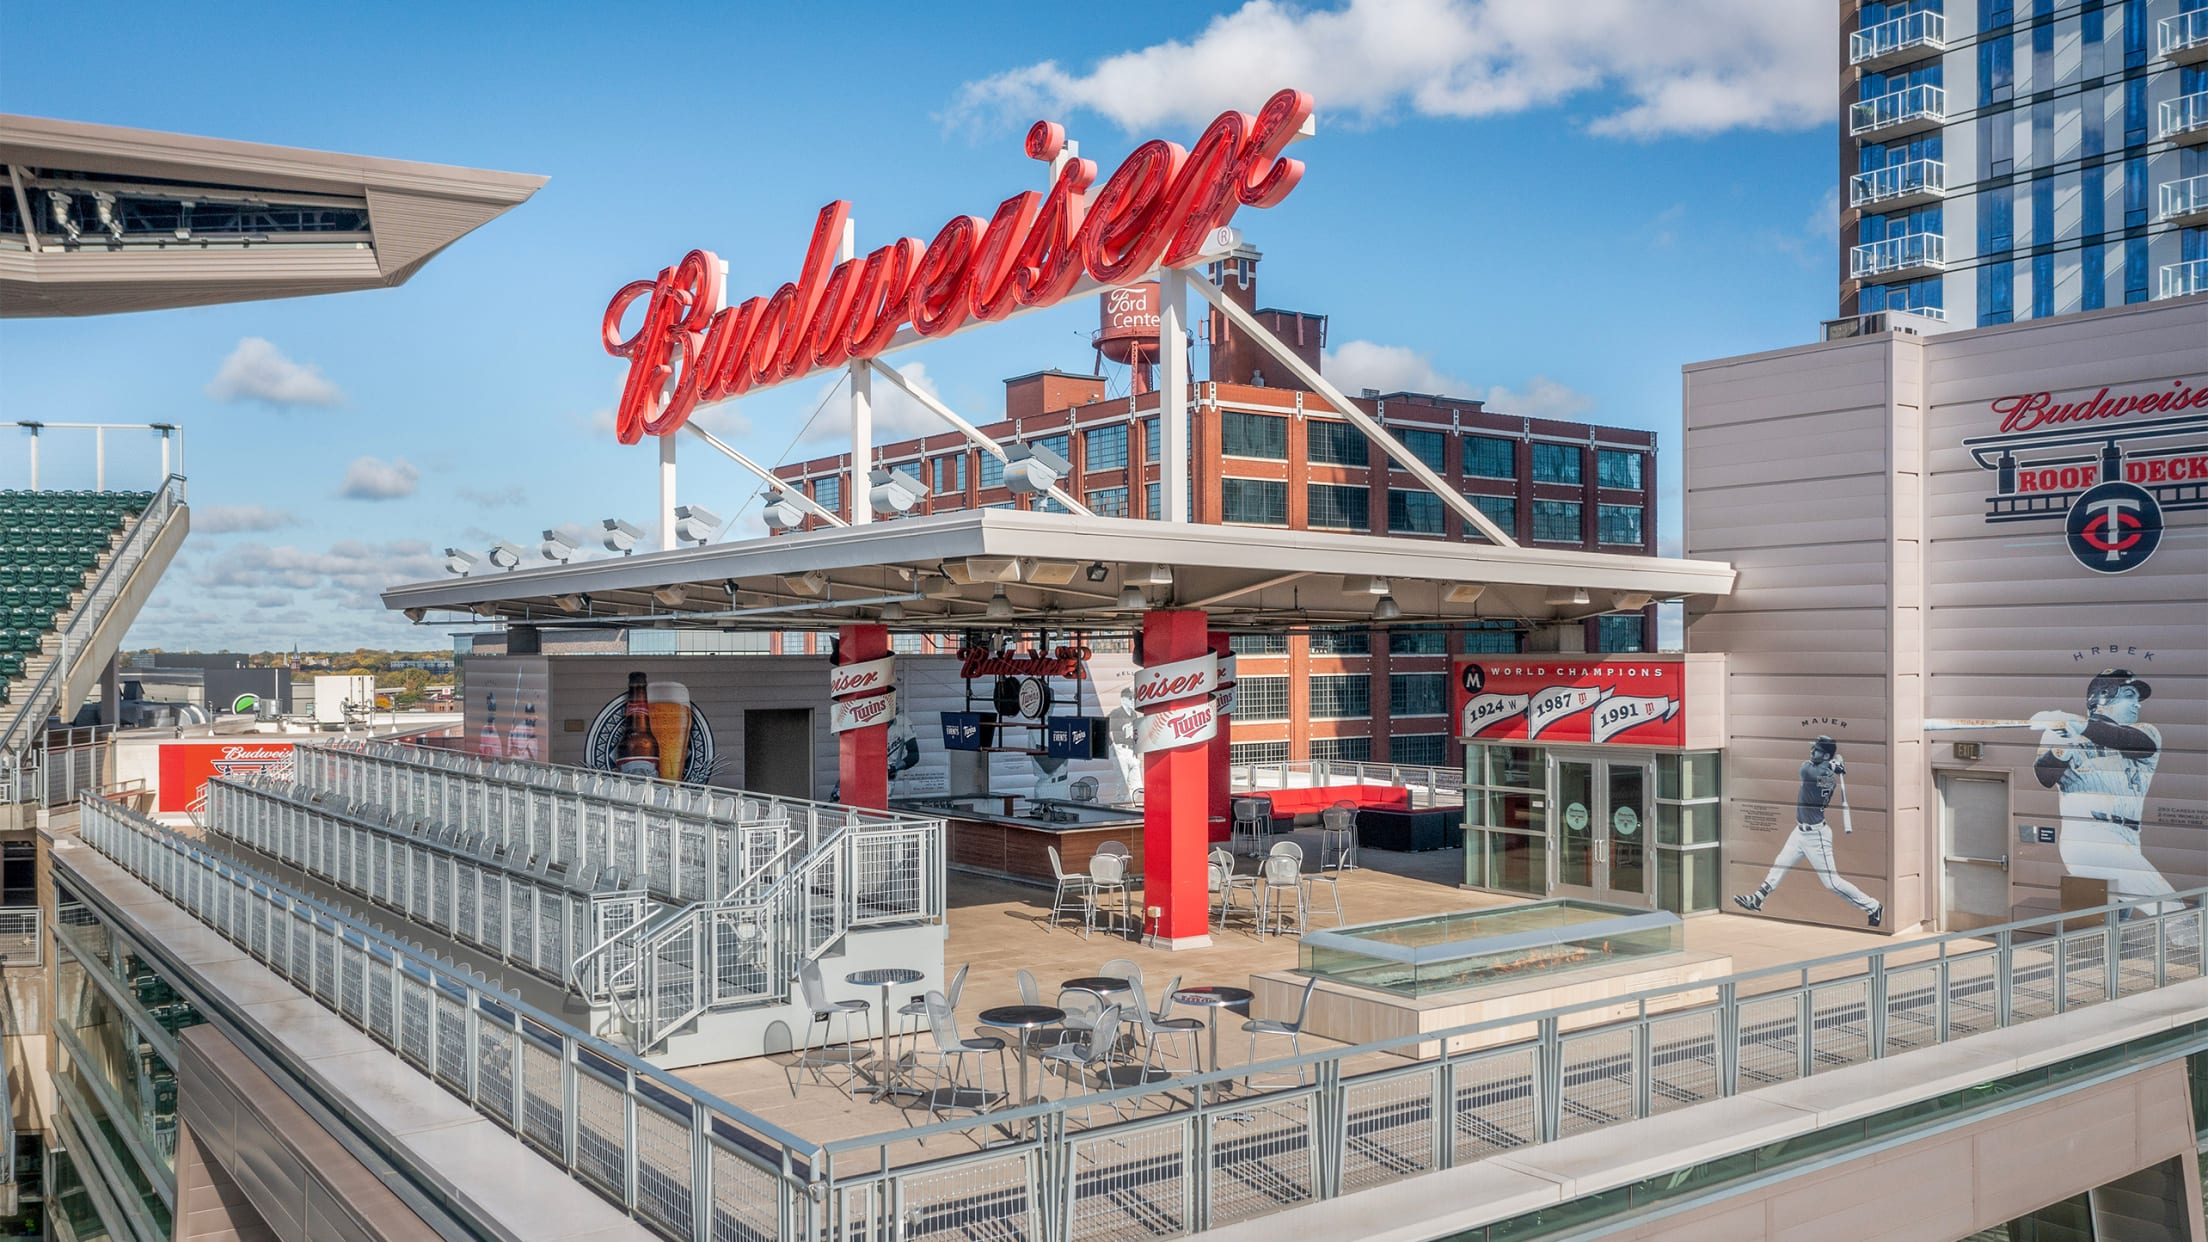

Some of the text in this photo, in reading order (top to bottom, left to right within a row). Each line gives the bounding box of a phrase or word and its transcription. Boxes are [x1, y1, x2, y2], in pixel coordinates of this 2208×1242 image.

[603, 88, 1314, 444] Budweiser
[1108, 288, 1147, 314] Ford
[1113, 313, 1160, 328] Cente
[2019, 457, 2208, 492] ROOF DECK
[2073, 644, 2155, 662] HRBEK
[1491, 667, 1663, 677] WORLD CHAMPIONS
[849, 700, 886, 723] Twins
[1470, 701, 1505, 724] 1924
[1537, 694, 1572, 718] 1987
[1600, 703, 1639, 728] 1991
[1167, 708, 1211, 739] Twins
[1801, 717, 1848, 728] MAUER
[1959, 744, 1974, 758] EXIT
